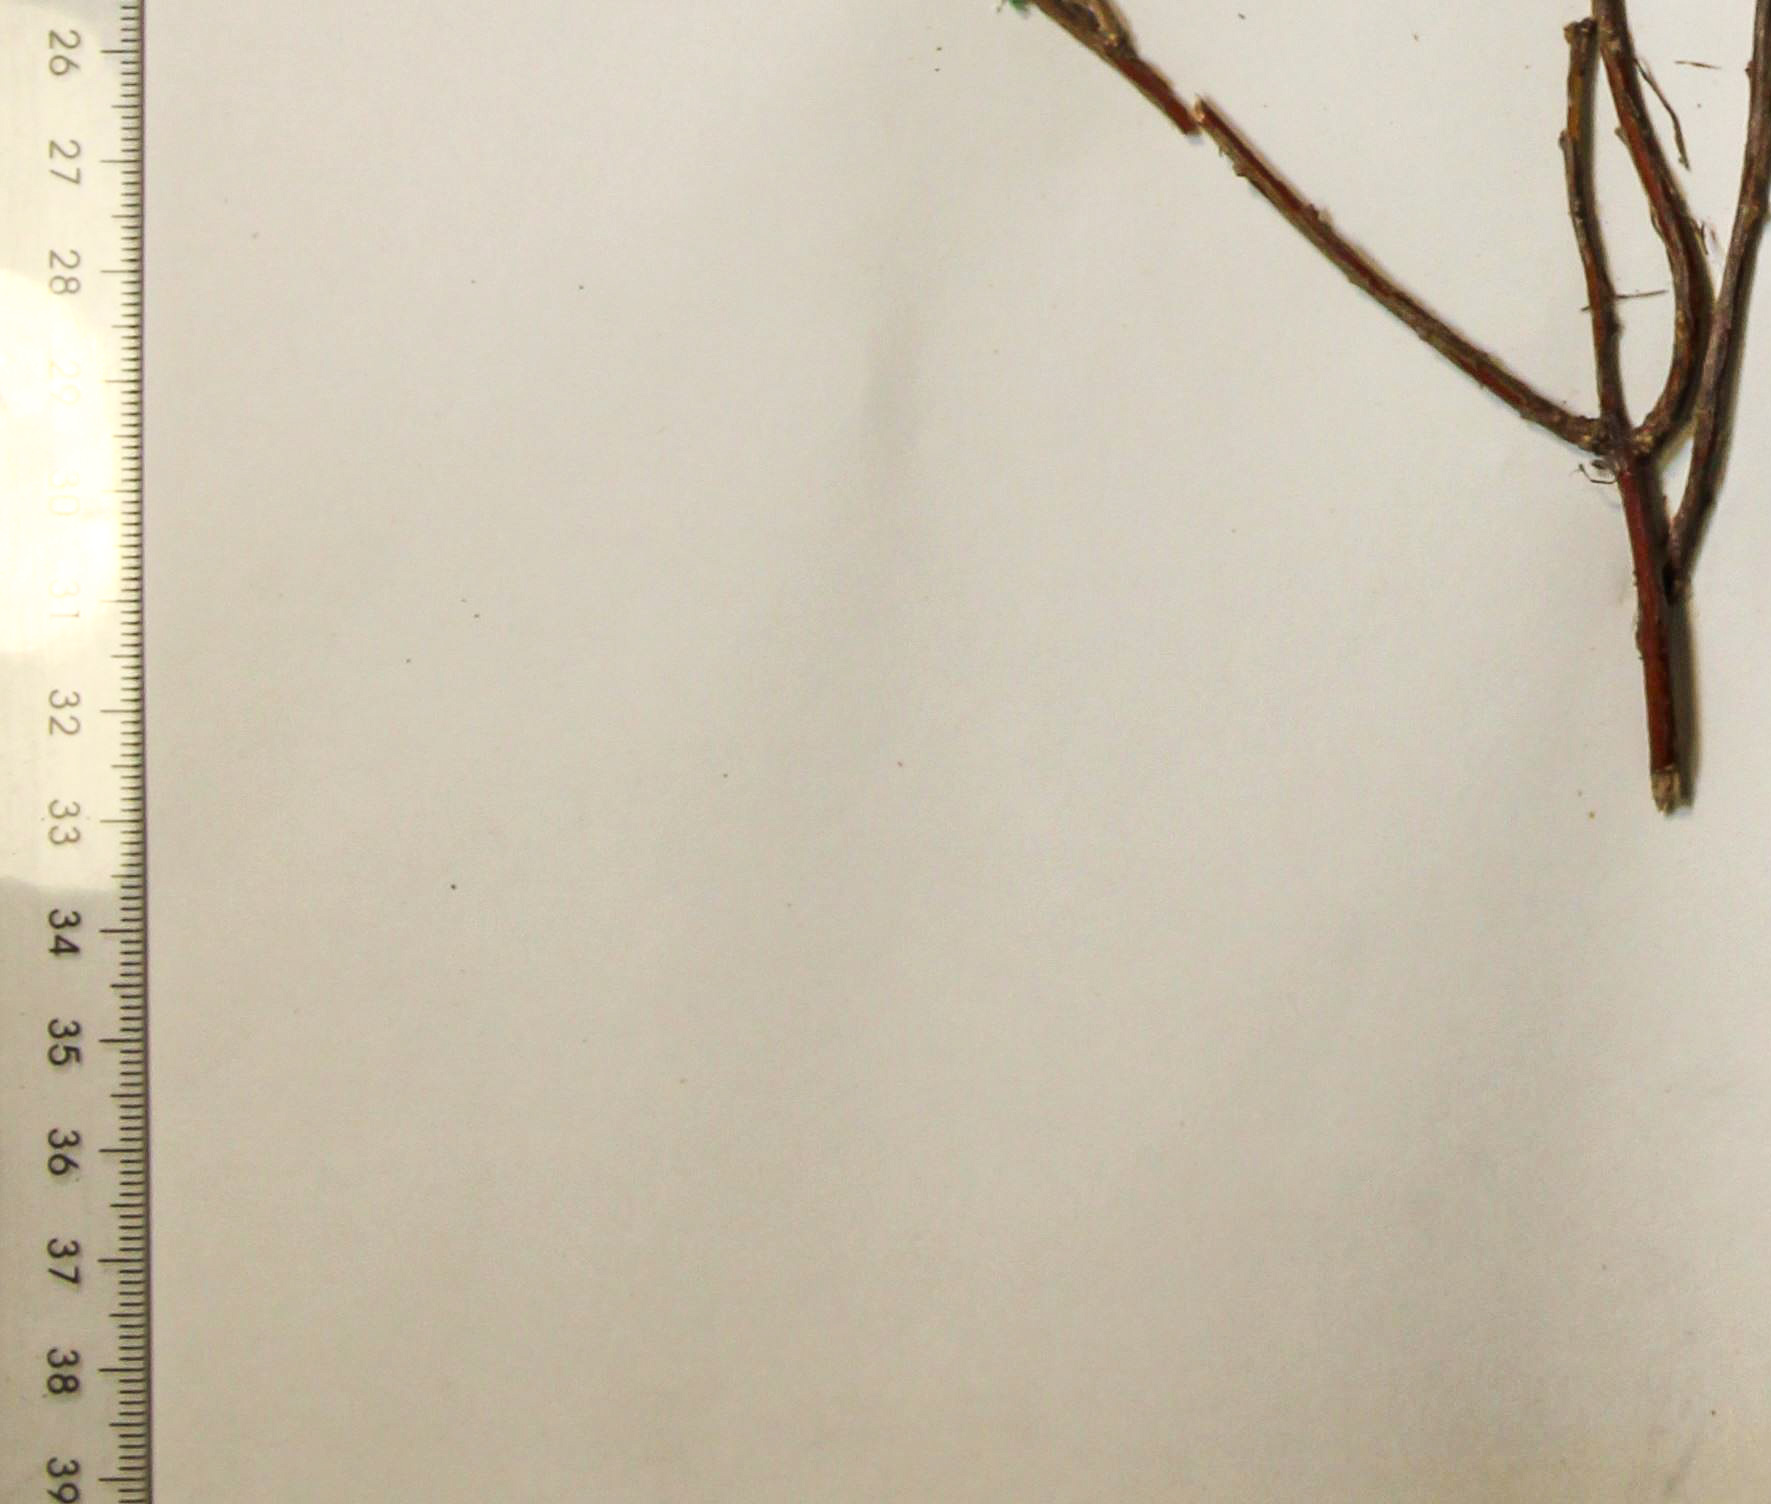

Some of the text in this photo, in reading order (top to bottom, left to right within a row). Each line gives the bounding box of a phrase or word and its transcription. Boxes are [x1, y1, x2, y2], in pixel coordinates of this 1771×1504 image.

[48, 30, 81, 77] 26
[49, 140, 81, 185] 27
[49, 250, 80, 295] 28
[48, 689, 80, 736] 32
[48, 799, 81, 846] 33
[47, 908, 82, 955] 34
[47, 1018, 82, 1065] 35
[47, 1128, 82, 1175] 36
[46, 1238, 82, 1285] 37
[47, 1348, 80, 1394] 38
[46, 1457, 80, 1503] 39
